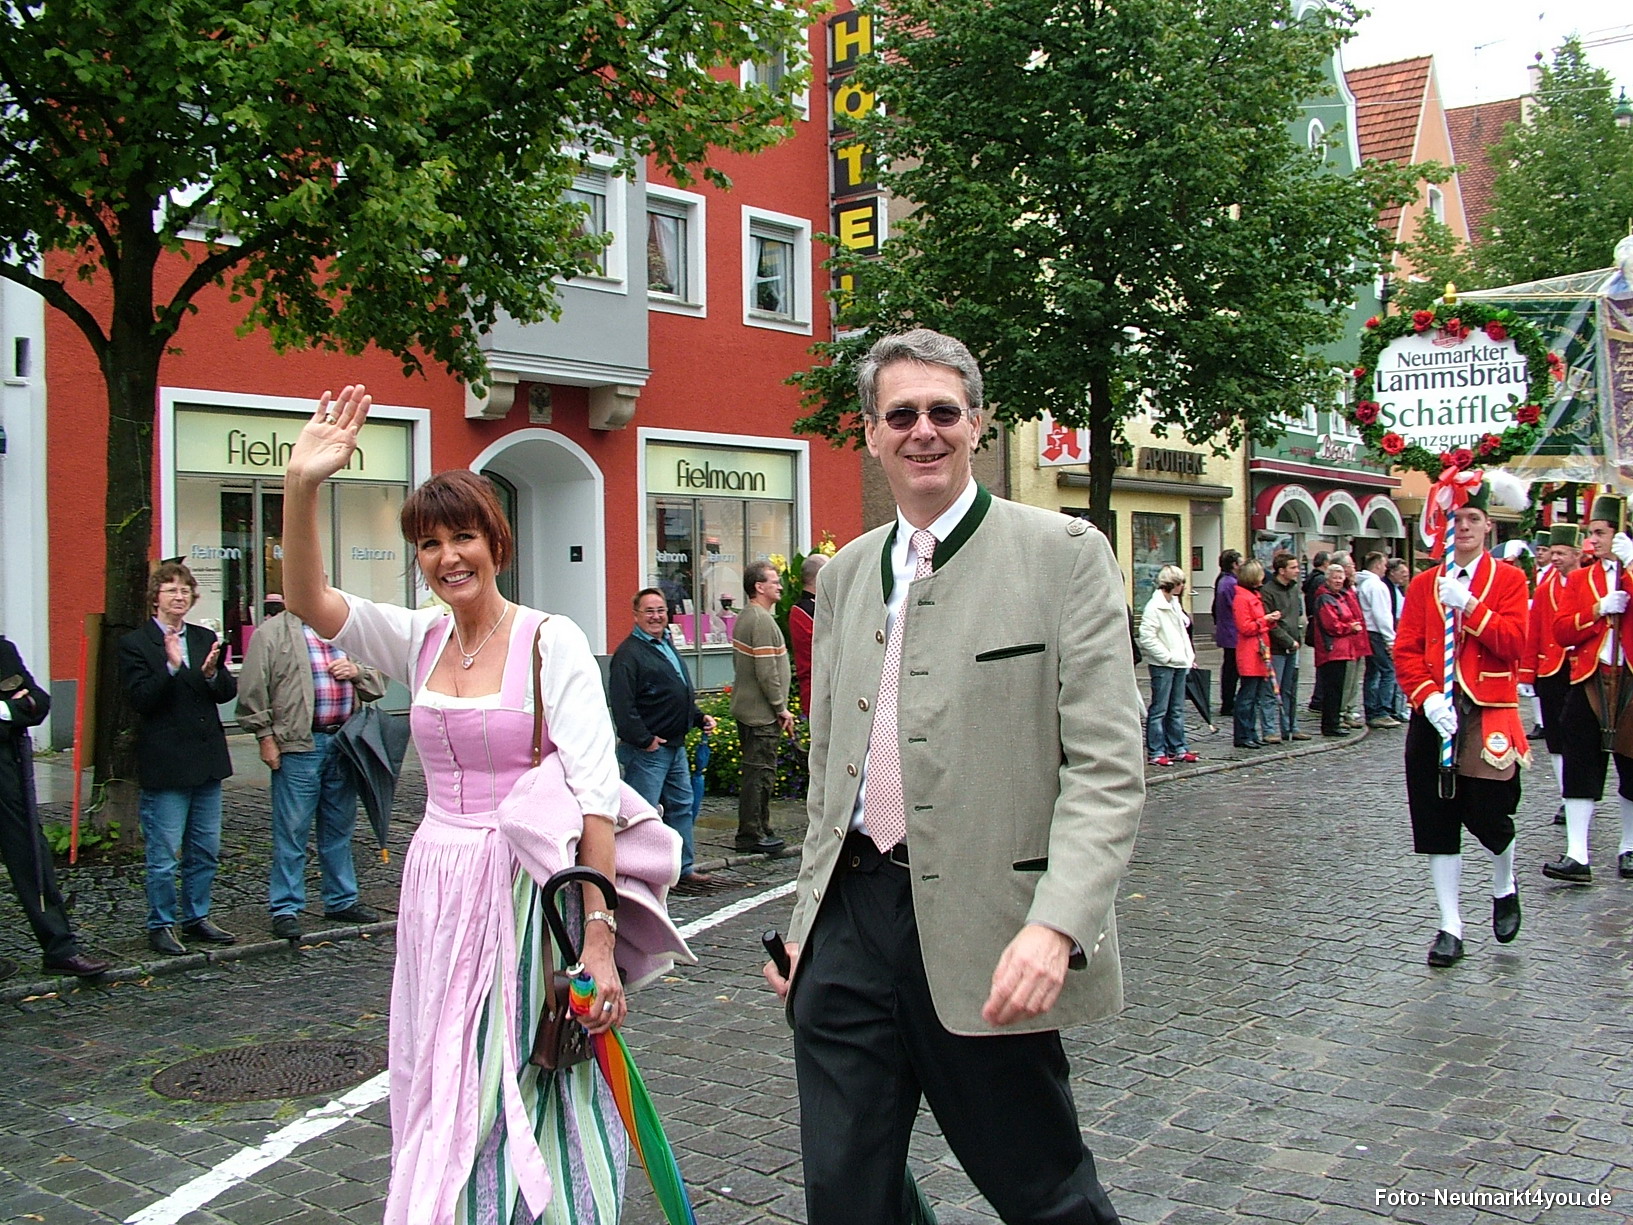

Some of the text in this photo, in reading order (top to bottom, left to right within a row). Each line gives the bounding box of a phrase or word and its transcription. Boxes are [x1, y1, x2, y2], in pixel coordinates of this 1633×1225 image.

[1397, 345, 1508, 368] Neumarkter
[1376, 362, 1528, 393] Lammsbräu
[228, 429, 364, 470] fielmn
[1143, 447, 1207, 475] APOTHEKE
[677, 459, 766, 491] fielmann
